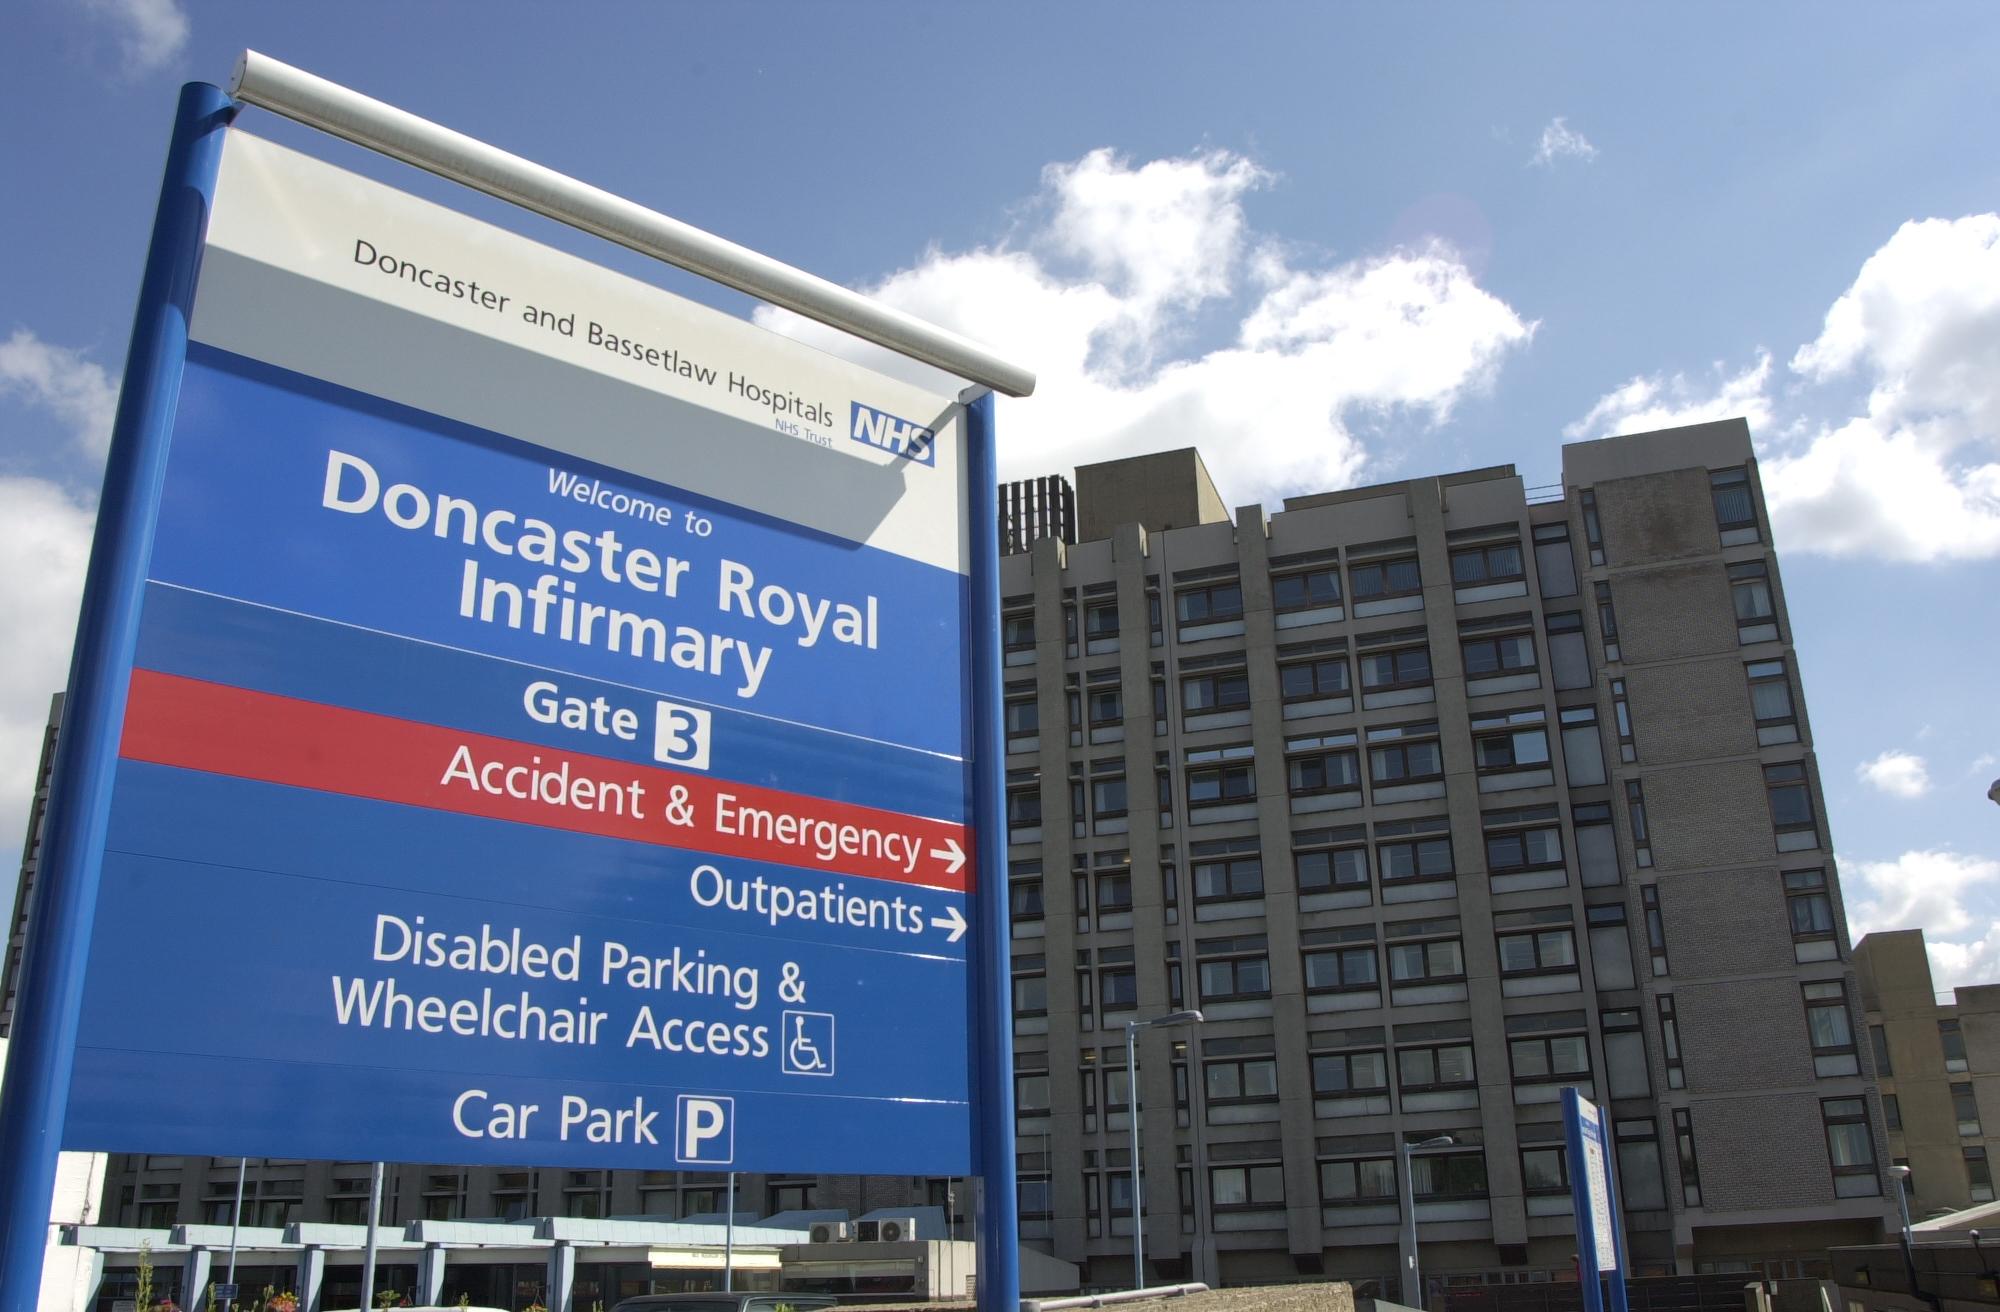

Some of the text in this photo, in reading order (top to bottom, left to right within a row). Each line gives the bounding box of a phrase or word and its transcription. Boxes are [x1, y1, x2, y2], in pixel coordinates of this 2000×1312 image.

[354, 239, 833, 428] Doncaster and Bassetlaw Hospitals
[775, 418, 833, 448] NHS Trust
[853, 406, 931, 461] NHS
[548, 467, 713, 537] Welcome to
[322, 449, 878, 650] Doncaster Royal
[459, 556, 773, 698] Infirmary
[523, 681, 699, 760] Gate 3
[440, 745, 922, 874] Accident & Emergency
[690, 865, 923, 934] Outpatients
[373, 914, 806, 1010] Disabled Parking &
[332, 975, 769, 1058] Wheelchair Access
[452, 1089, 658, 1145] Car Park
[685, 1100, 725, 1158] P
